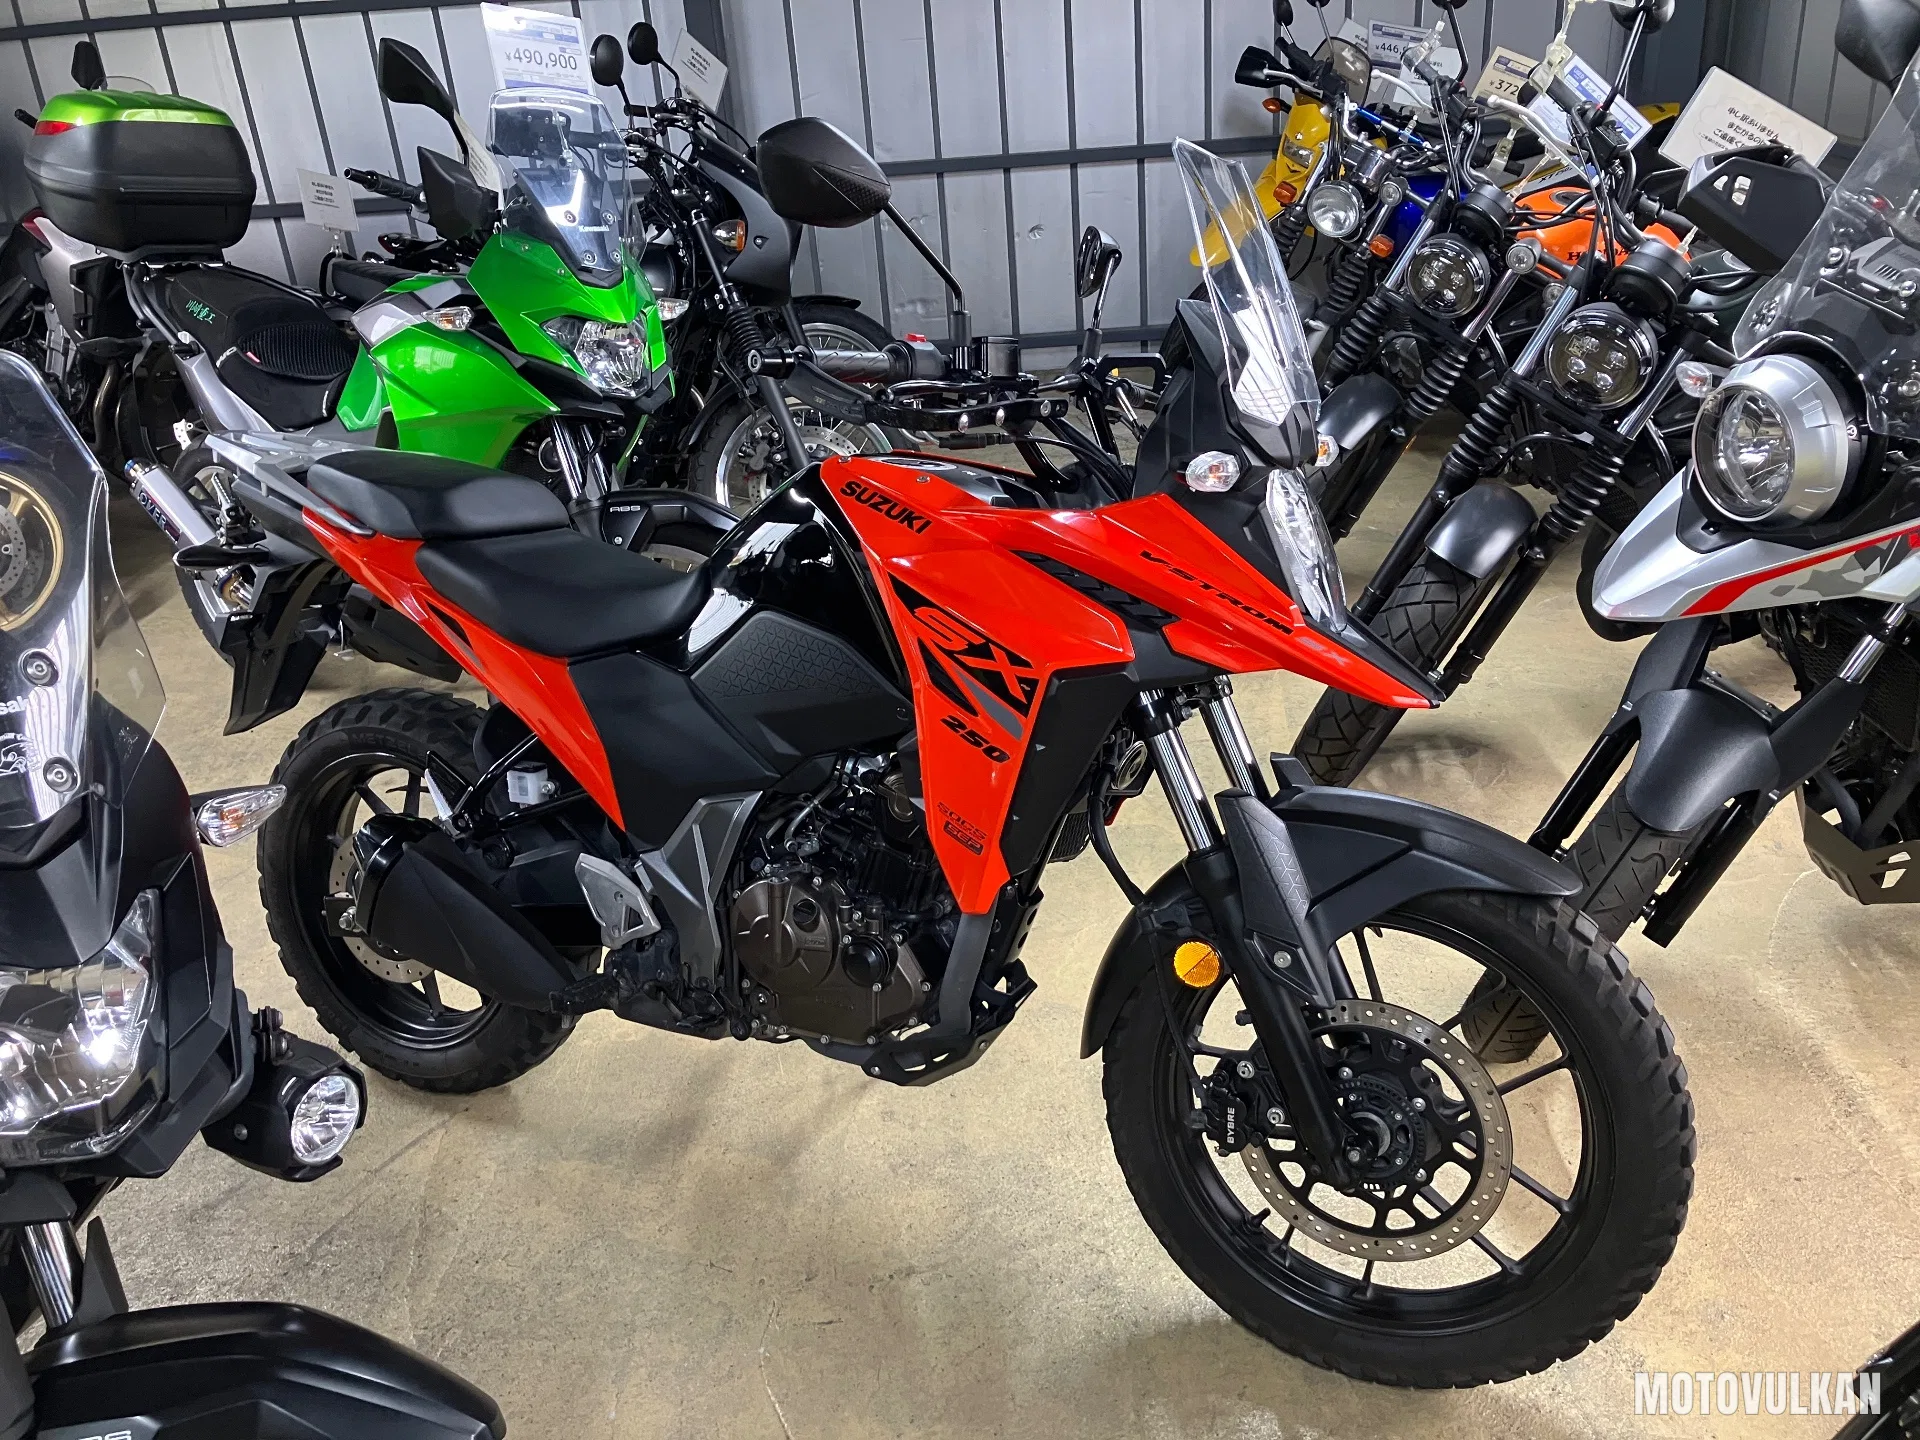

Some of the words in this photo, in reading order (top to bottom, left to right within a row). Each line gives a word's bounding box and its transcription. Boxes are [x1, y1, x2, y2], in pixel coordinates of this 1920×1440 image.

[504, 47, 577, 70] ¥490,900
[1489, 78, 1520, 96] ¥372
[1727, 106, 1779, 139] 申し訳ありません
[138, 491, 167, 532] OVER
[610, 505, 641, 513] ABS
[840, 480, 933, 534] SUZUKI
[1139, 550, 1294, 635] V-STROM
[914, 606, 1042, 705] SX
[940, 714, 1011, 764] 250
[947, 824, 981, 849] SEP
[1226, 1106, 1235, 1144] BYBRE
